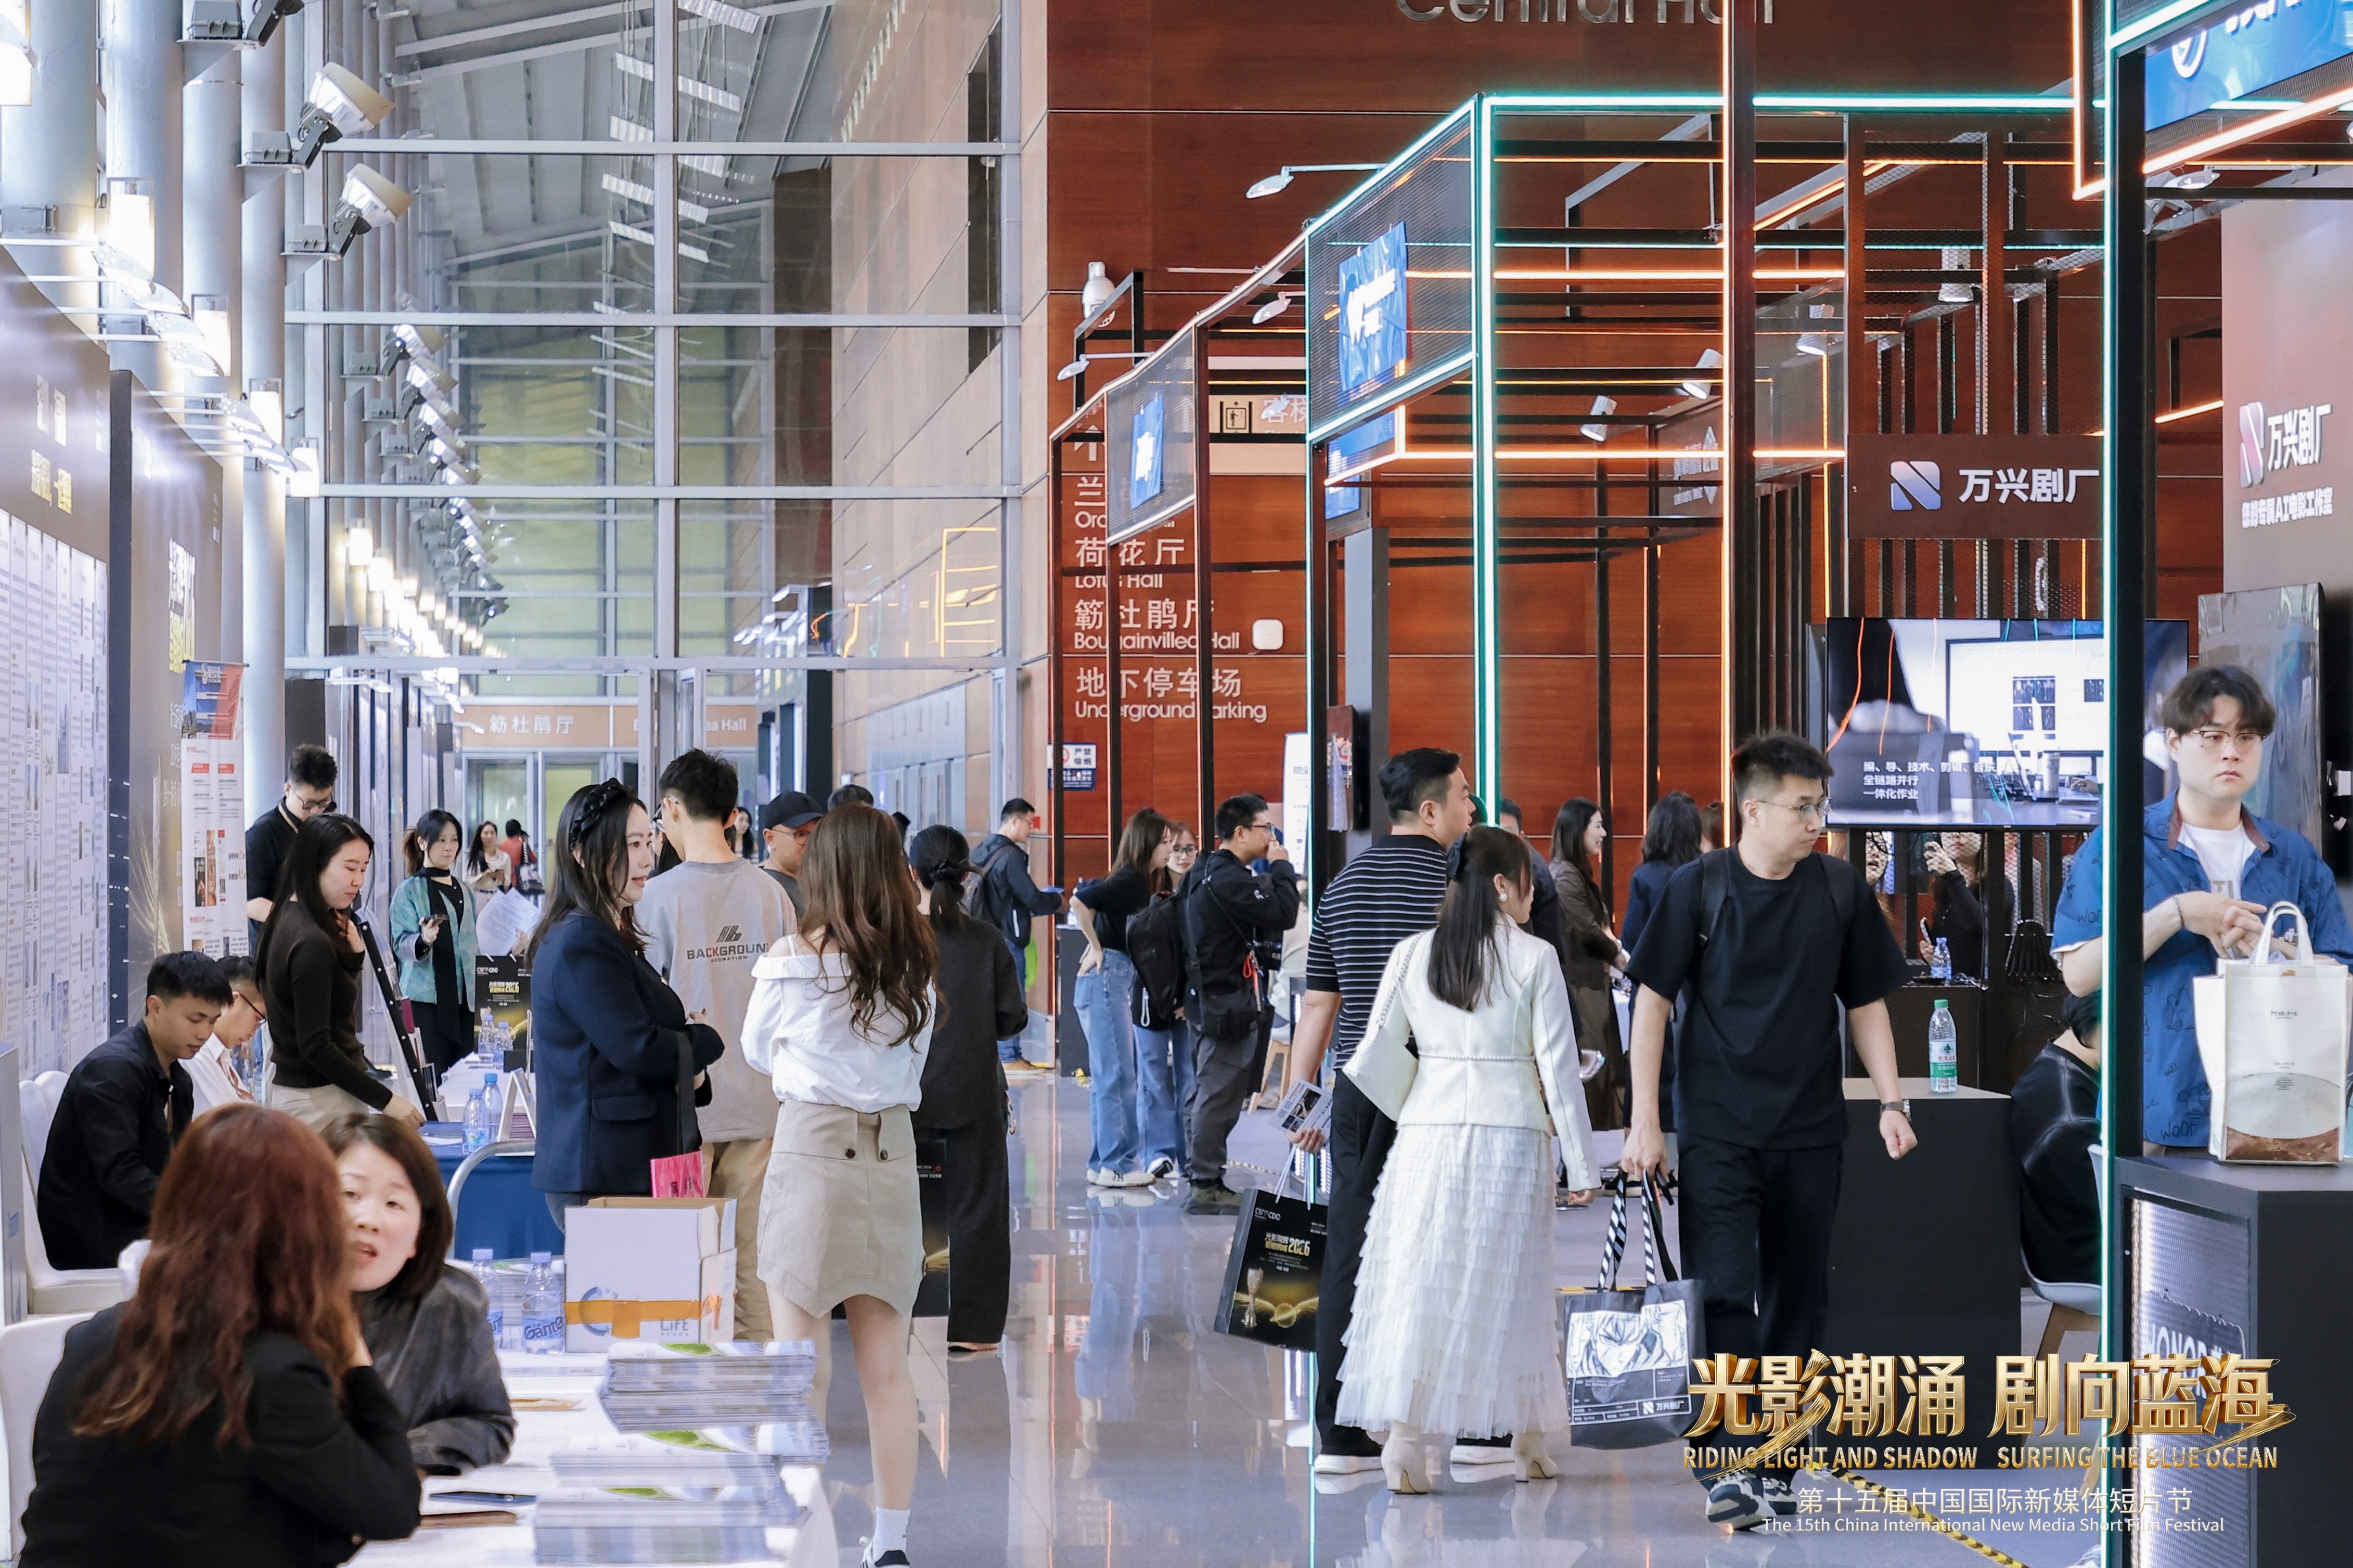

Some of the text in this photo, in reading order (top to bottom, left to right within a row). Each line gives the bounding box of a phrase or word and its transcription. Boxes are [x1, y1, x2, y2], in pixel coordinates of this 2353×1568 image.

[2267, 404, 2332, 471] 万兴剧厂
[1958, 468, 2100, 504] 万兴剧厂
[1075, 536, 1185, 567] 荷花厅
[1127, 574, 1163, 588] Hall
[1074, 631, 1197, 650] Bouainvillea
[1076, 667, 1242, 698] 地下停车场
[1075, 701, 1268, 723] Undrground arking
[722, 717, 747, 731] Hall
[1863, 775, 1919, 786] 全链路并行
[1863, 788, 1919, 799] 一体化作业
[687, 943, 769, 960] BACKGROUN
